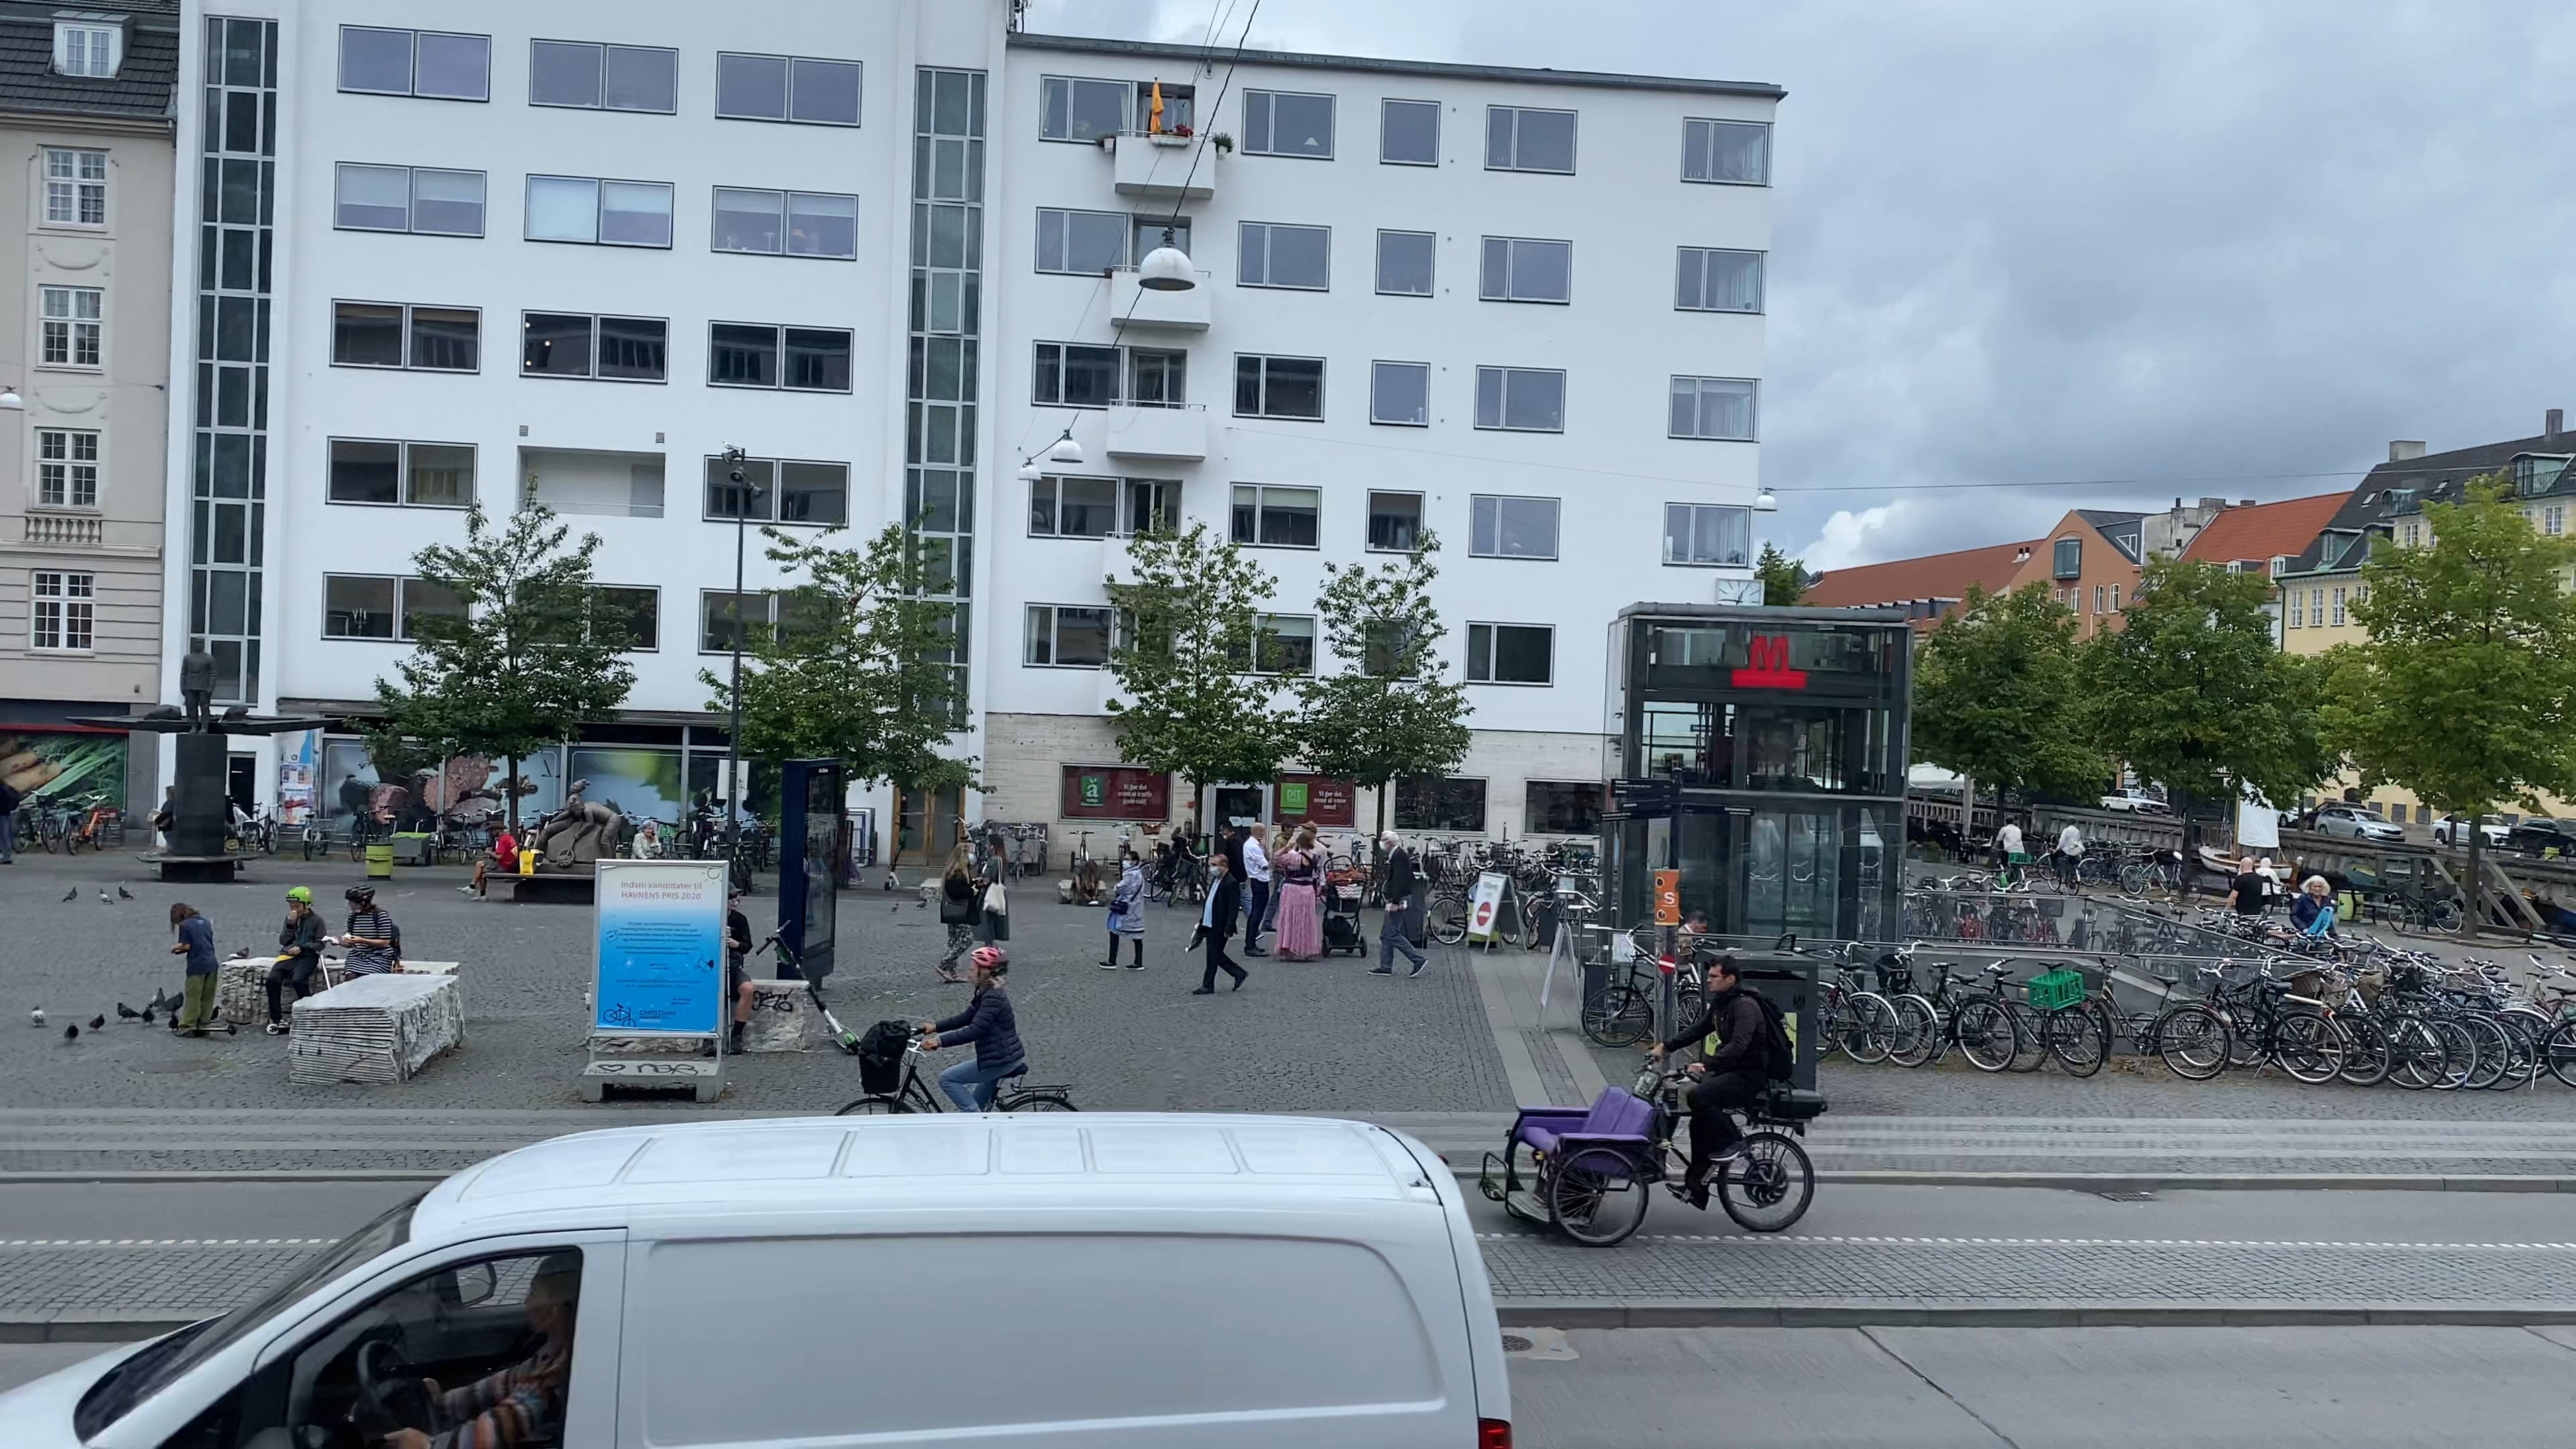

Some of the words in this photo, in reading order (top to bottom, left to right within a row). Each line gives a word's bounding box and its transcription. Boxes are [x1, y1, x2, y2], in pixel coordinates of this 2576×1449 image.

[648, 881, 692, 890] kandidater
[621, 891, 659, 900] HAVNENS
[661, 892, 679, 900] PRIS
[1664, 891, 1676, 905] S
